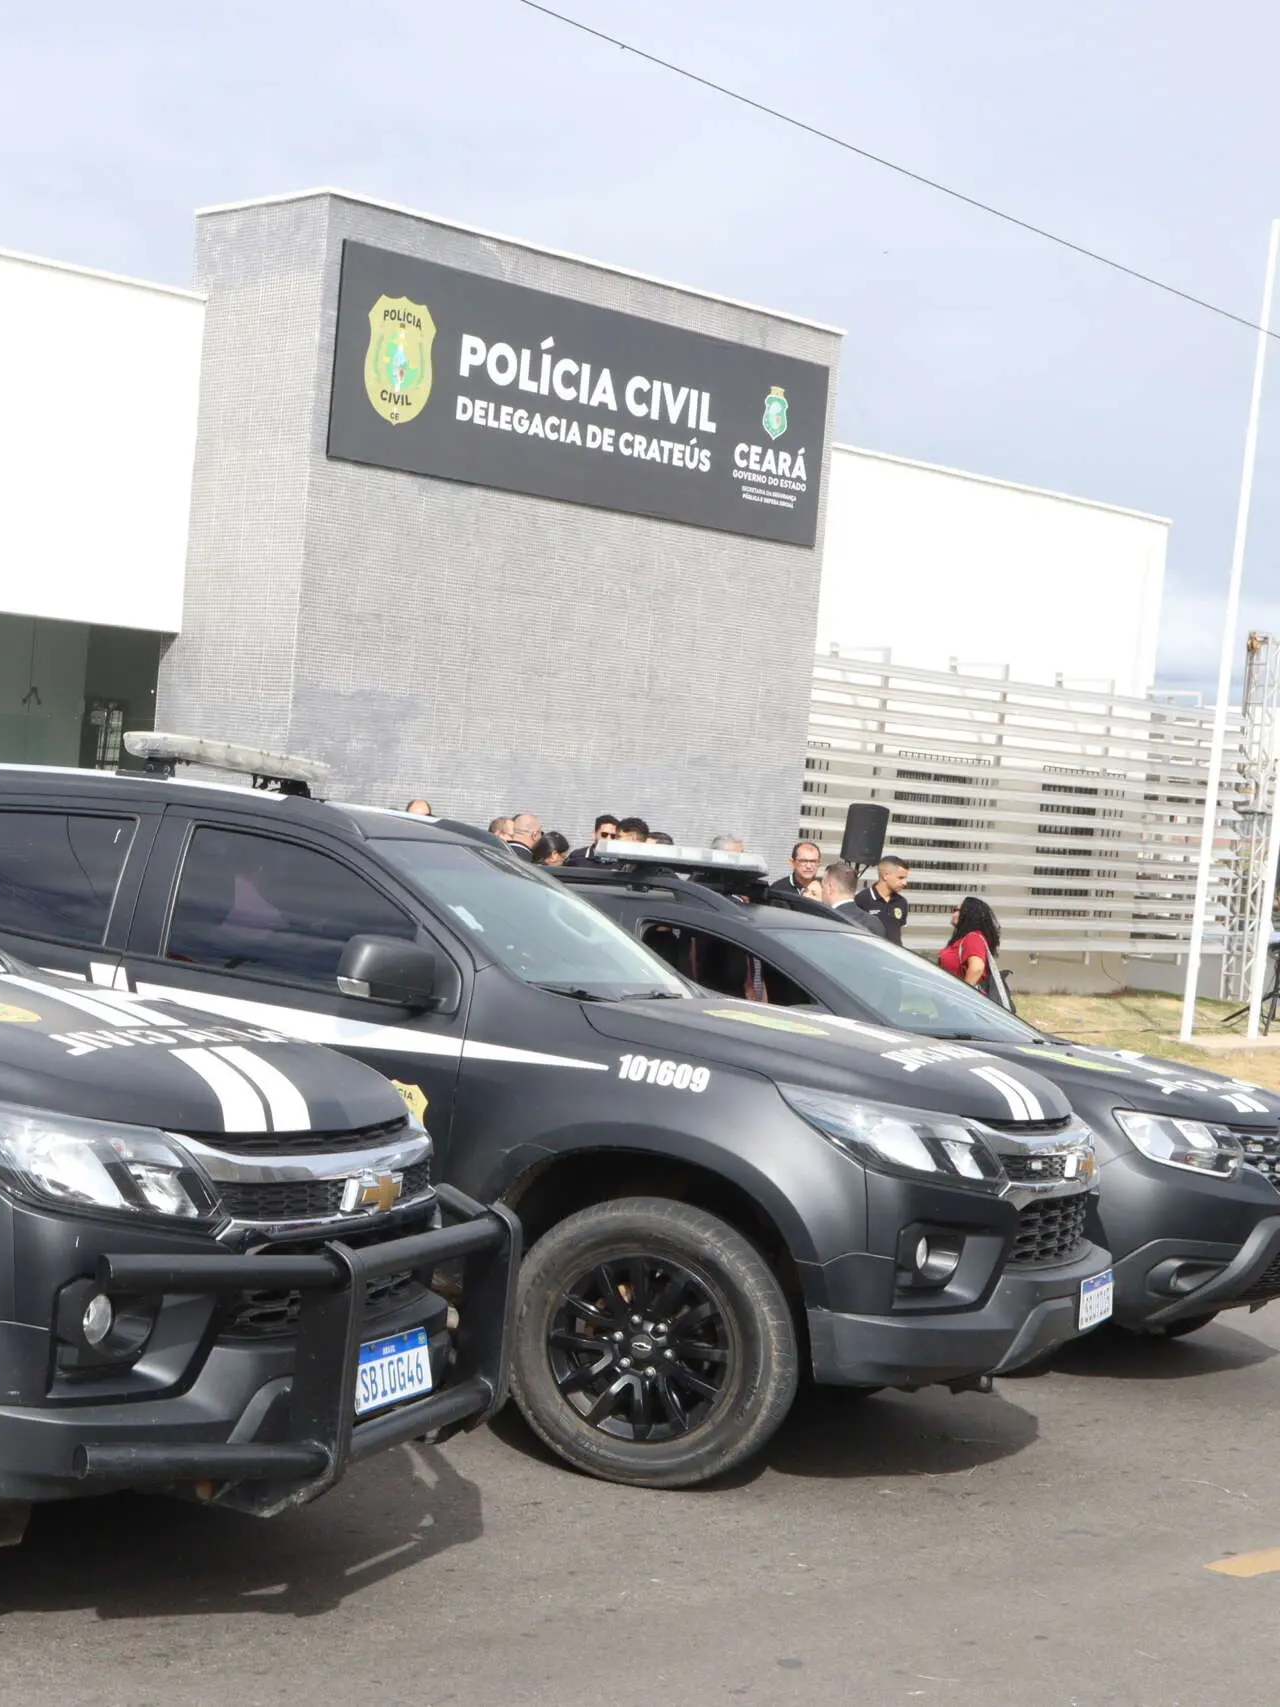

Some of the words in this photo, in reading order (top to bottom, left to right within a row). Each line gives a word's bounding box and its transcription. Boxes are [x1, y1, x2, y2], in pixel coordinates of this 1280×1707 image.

[383, 308, 422, 330] POLÍCIA
[380, 389, 412, 406] CIVIL
[459, 333, 618, 412] POLÍCIA
[625, 375, 717, 433] CIVIL
[455, 395, 582, 446] DELEGACIA
[586, 424, 615, 452] DE
[619, 432, 712, 473] CRATEÚS
[734, 442, 807, 480] CEARÁ
[732, 469, 766, 484] GOVERNO
[768, 476, 779, 486] DO
[780, 479, 807, 492] ESTADO
[618, 1054, 711, 1093] 101609
